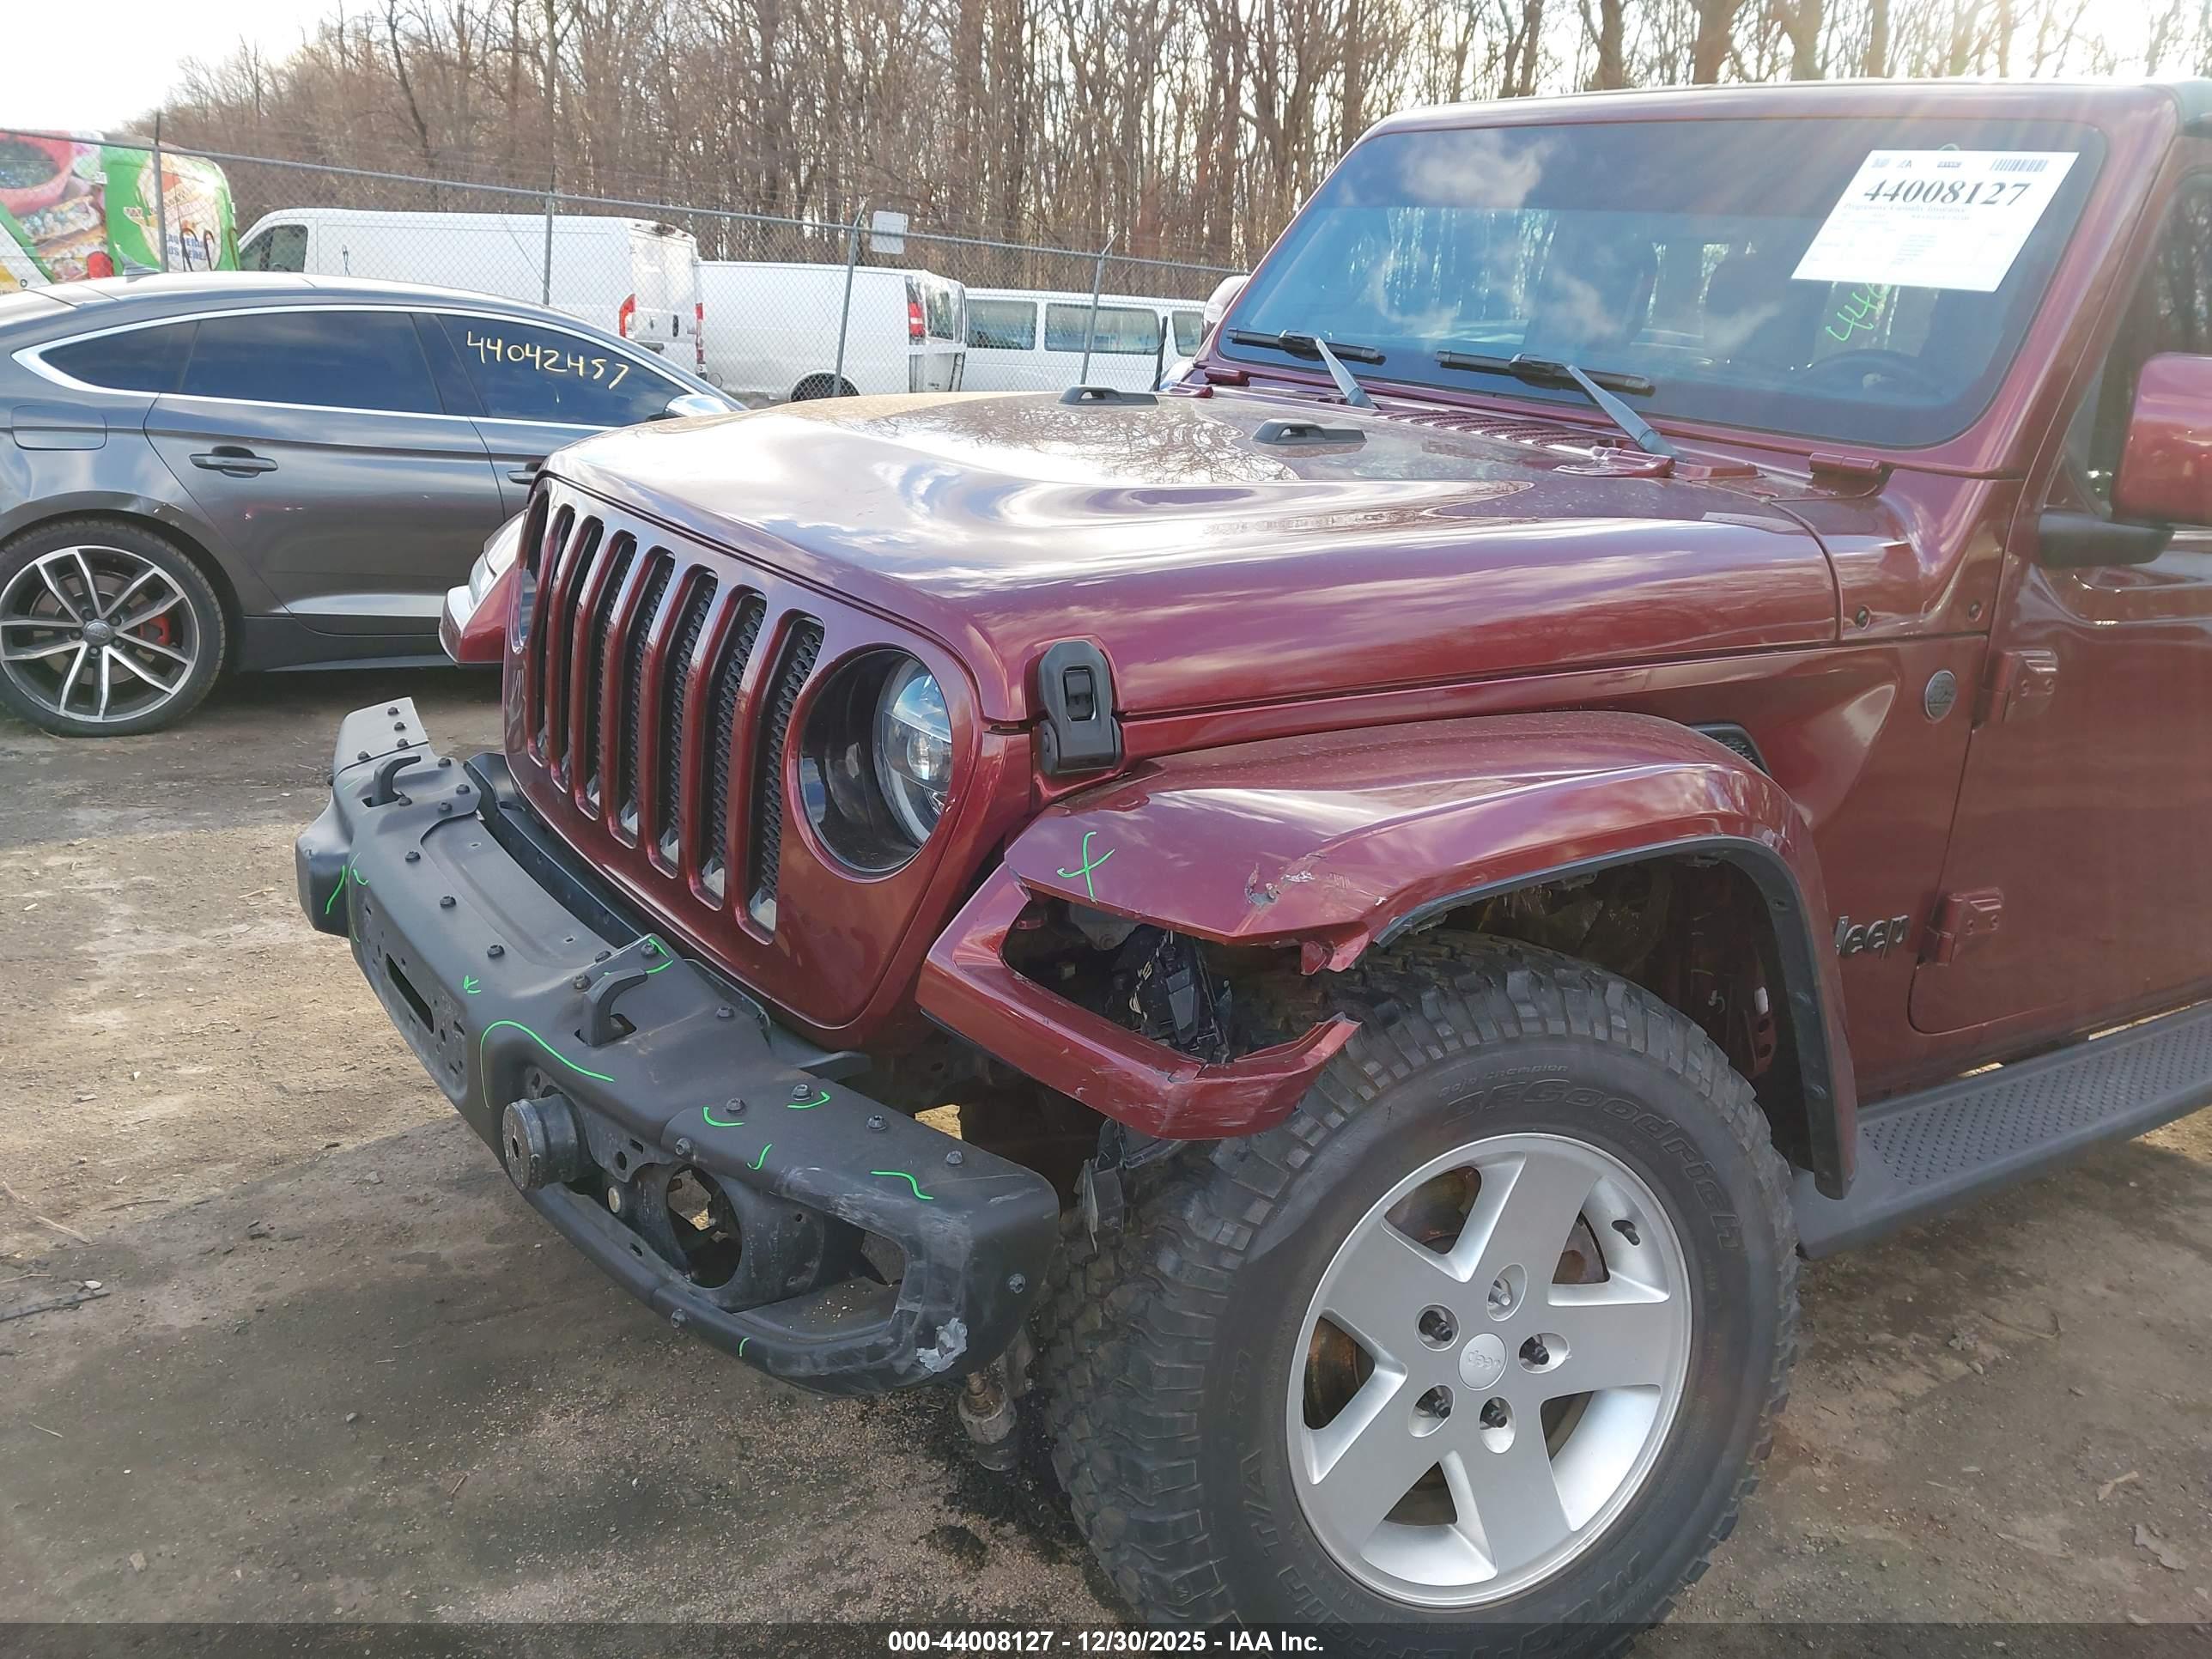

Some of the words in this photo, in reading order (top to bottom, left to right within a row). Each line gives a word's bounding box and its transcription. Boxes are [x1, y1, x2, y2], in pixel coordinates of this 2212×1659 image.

[1863, 178, 2032, 206] 44008127
[466, 330, 629, 391] 44042457
[1835, 915, 1909, 960] Jeep
